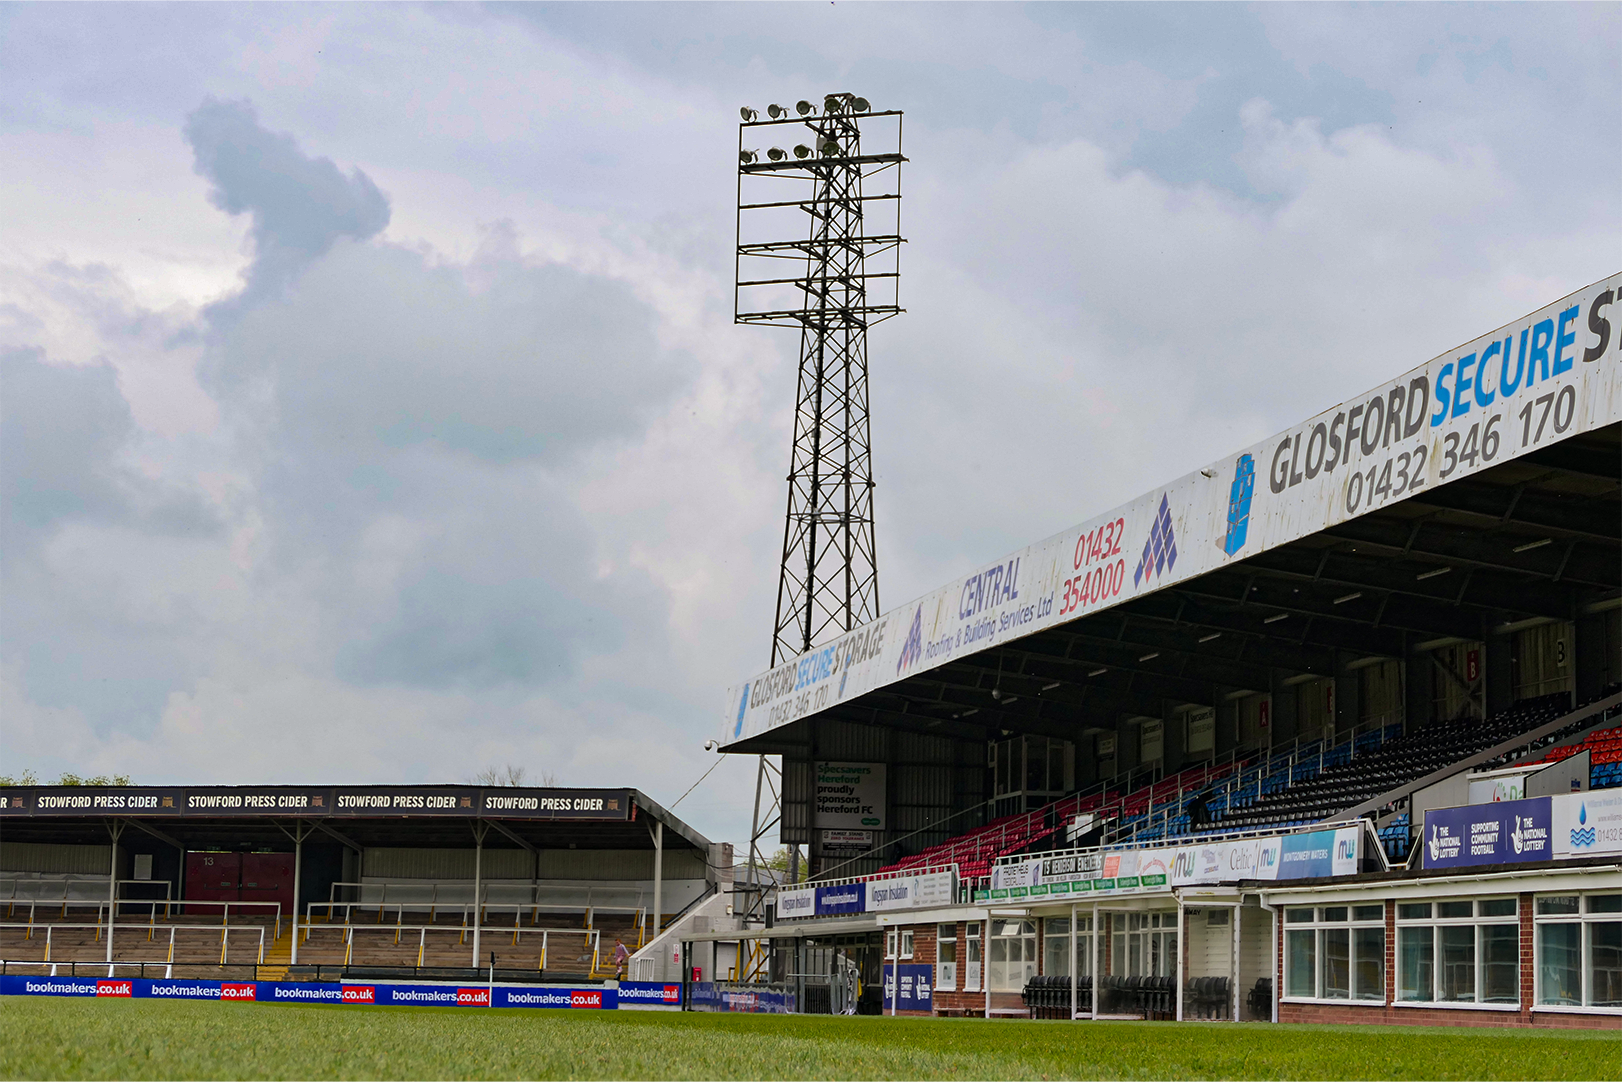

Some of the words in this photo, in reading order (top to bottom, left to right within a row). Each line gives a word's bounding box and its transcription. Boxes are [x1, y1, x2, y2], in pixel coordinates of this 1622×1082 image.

[1270, 375, 1430, 494] GLOSFORD
[1431, 304, 1580, 427] SECURE
[1582, 285, 1622, 363] S
[1346, 445, 1428, 514] 01432
[1440, 414, 1502, 479] 346
[1519, 385, 1576, 448] 170
[1074, 517, 1125, 570] 01432
[959, 557, 1020, 620] CENTRAL
[1060, 558, 1125, 615] 354000
[925, 635, 954, 661] Roofing
[955, 631, 963, 649] &
[964, 621, 996, 644] Building
[998, 604, 1033, 632] Services
[1037, 591, 1054, 620] Ltd
[751, 663, 797, 709] GLOSFORD
[795, 646, 836, 691] SECURE
[832, 621, 887, 675] STORAGE
[769, 702, 791, 727] 01432
[793, 691, 811, 717] 346
[813, 684, 829, 709] 170
[817, 764, 871, 775] Specsavers
[817, 775, 860, 784] Hereford
[817, 785, 855, 795] proudly
[38, 796, 91, 808] STOWFORD
[94, 796, 125, 808] PRESS
[127, 796, 158, 808] CIDER
[188, 795, 241, 808] STOWFORD
[244, 795, 276, 808] PRESS
[278, 795, 308, 808] CIDER
[338, 795, 391, 808] STOWFORD
[393, 795, 424, 808] PRESS
[426, 796, 456, 809] CIDER
[485, 797, 538, 810] STOWFORD
[540, 797, 571, 810] PRESS
[573, 798, 604, 811] CIDER
[817, 796, 860, 805] sponsors
[817, 804, 860, 814] Hereford
[861, 805, 873, 814] FC
[1470, 821, 1500, 834] SUPPORTING
[1523, 818, 1533, 828] THE
[1439, 826, 1449, 836] THE
[1523, 828, 1548, 840] NATIONAL
[1597, 828, 1618, 842] 01432
[1439, 836, 1461, 847] NATIONAL
[1470, 833, 1499, 845] COMMUNITY
[1470, 844, 1495, 856] FOOTBALL
[1523, 840, 1546, 852] LOTTERY
[1311, 849, 1329, 860] WATERS
[1439, 847, 1459, 858] LOTTERY
[203, 856, 214, 866] 13
[26, 981, 130, 994] bookmakers.co.uk
[151, 985, 254, 997] bookmakers.co.uk
[274, 987, 373, 1000] bookmakers.co.uk
[618, 987, 679, 999] bookmakers.co.uk
[392, 990, 488, 1002] bookmakers.co.uk
[507, 992, 600, 1005] bookmakers.co.uk
